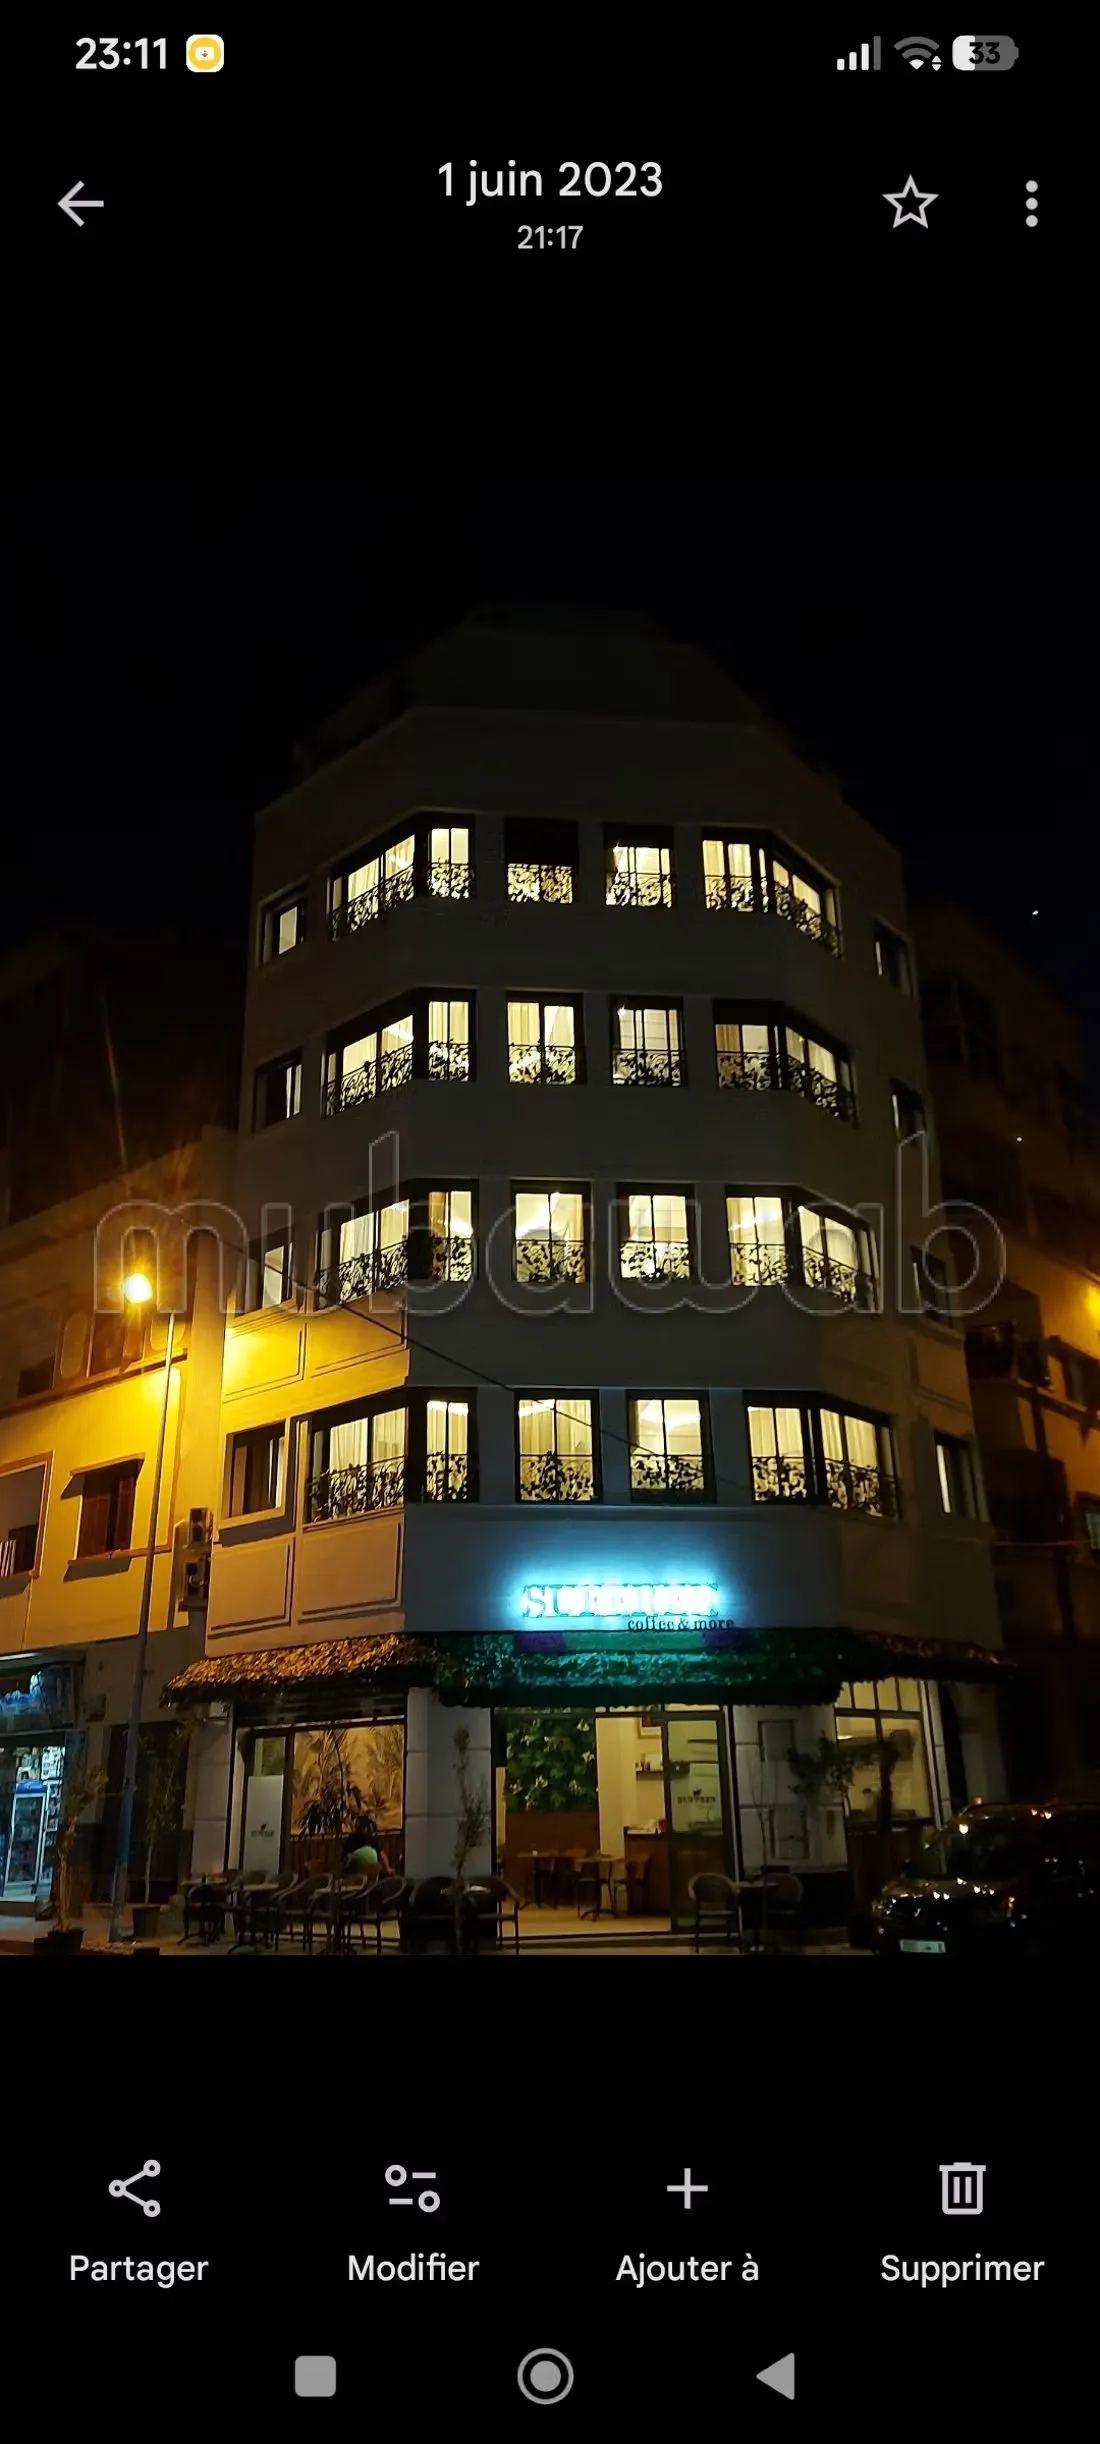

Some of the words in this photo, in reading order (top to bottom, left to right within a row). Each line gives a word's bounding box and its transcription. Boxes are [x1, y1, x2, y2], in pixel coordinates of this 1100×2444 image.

[627, 1615, 675, 1631] coffee
[678, 1618, 689, 1630] &
[693, 1618, 735, 1630] more
